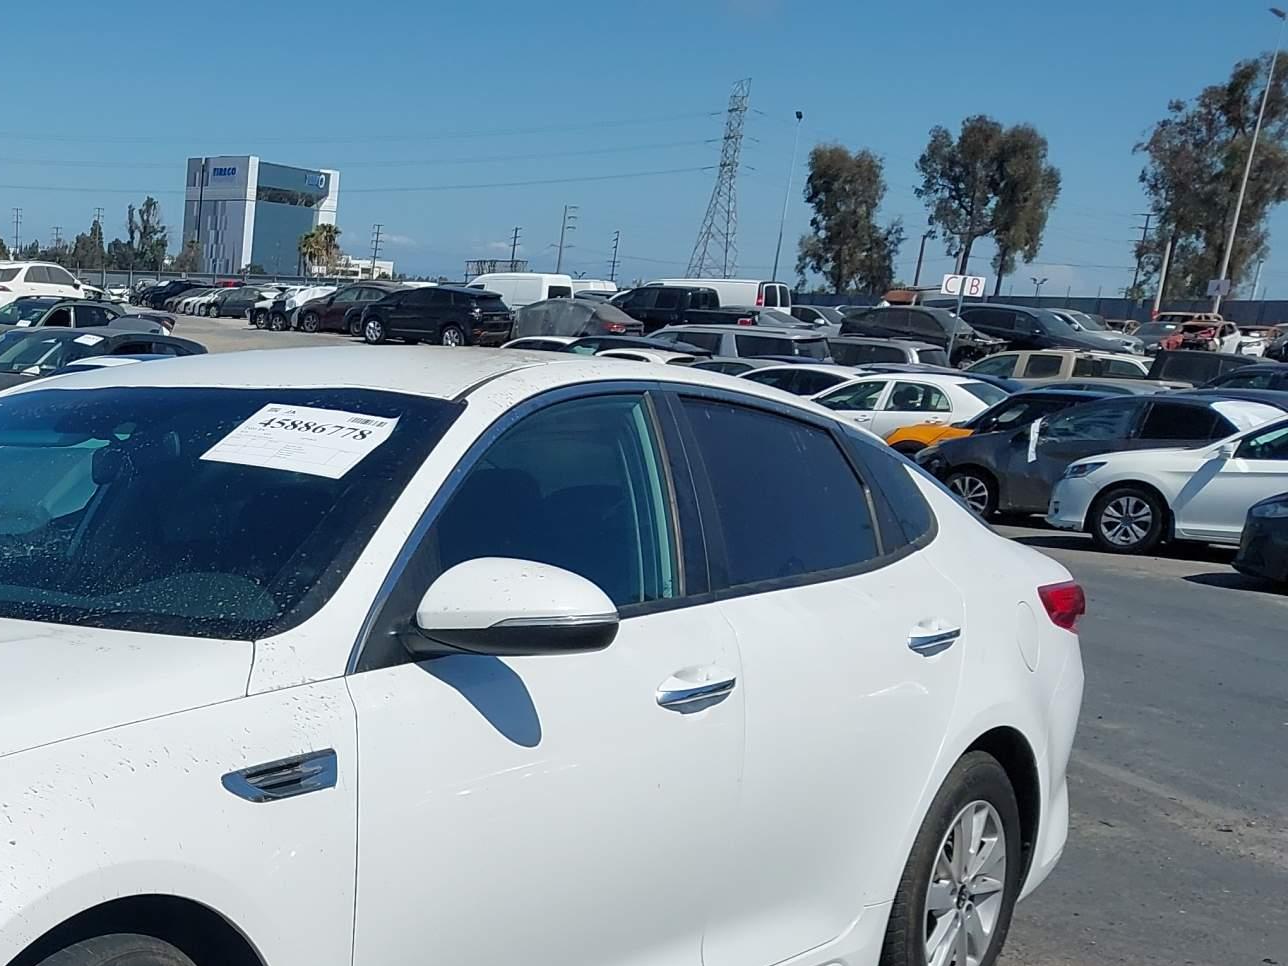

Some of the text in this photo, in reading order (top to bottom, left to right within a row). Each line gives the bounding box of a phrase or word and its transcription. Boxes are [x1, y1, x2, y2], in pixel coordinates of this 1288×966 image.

[945, 276, 959, 294] C
[969, 277, 981, 296] B
[258, 417, 372, 441] 45886778
